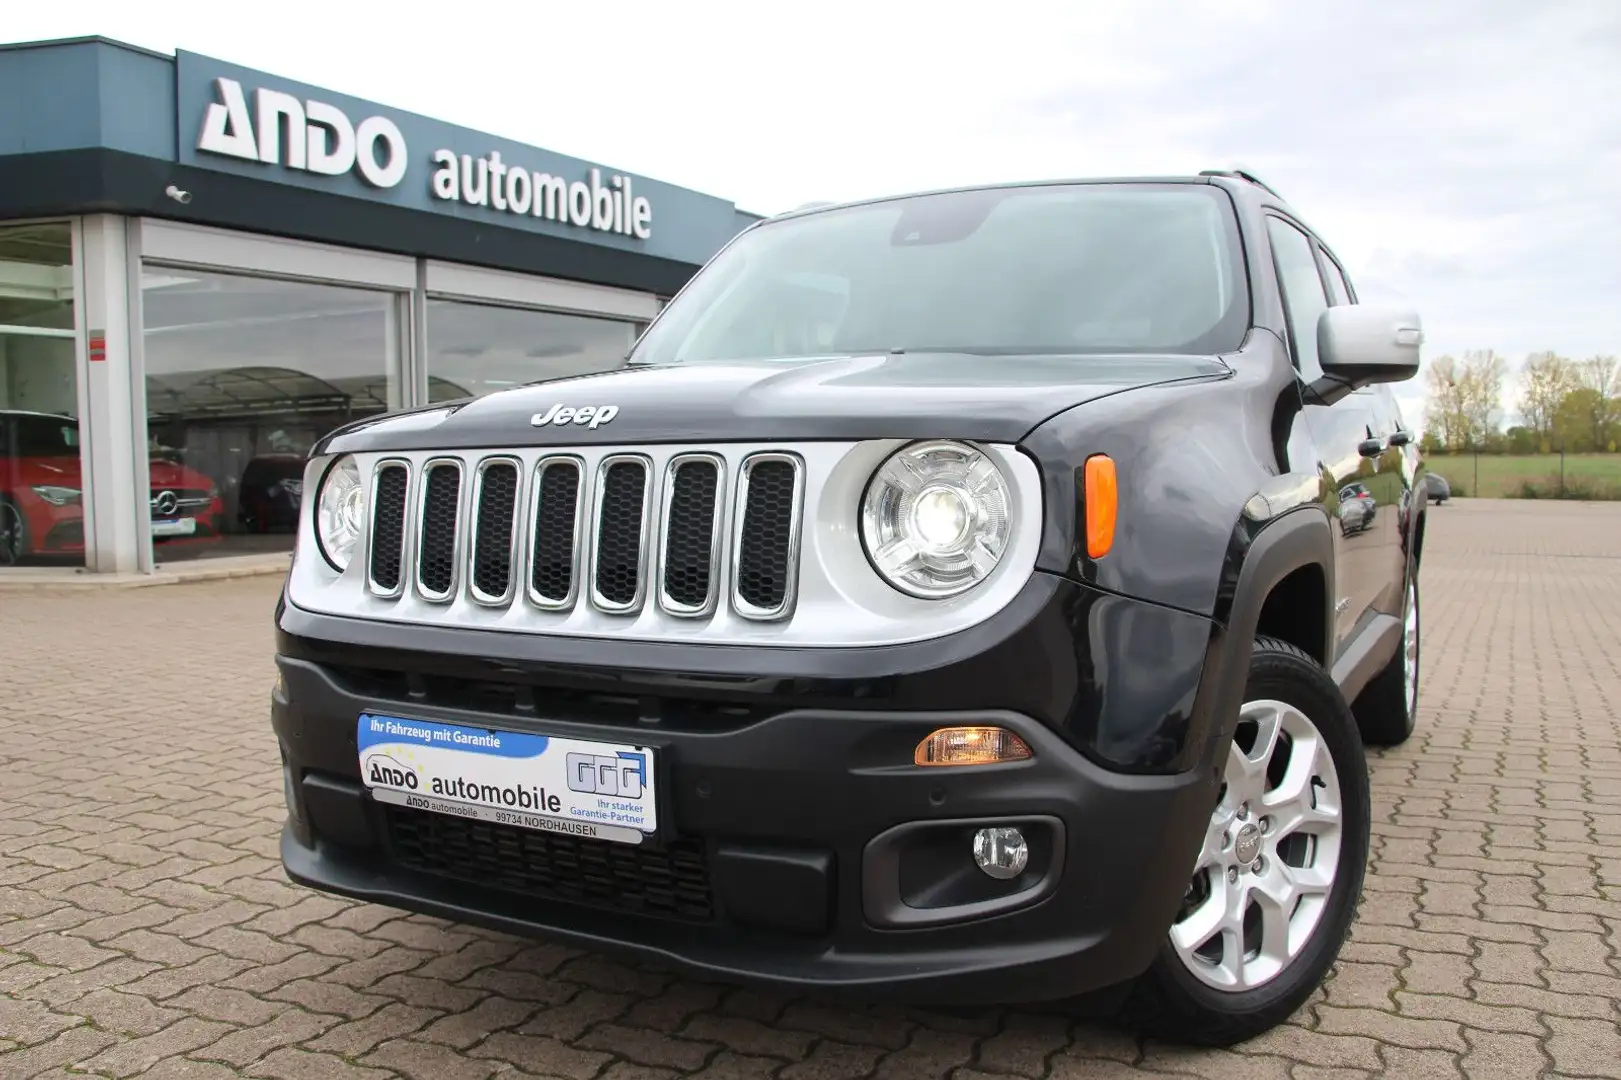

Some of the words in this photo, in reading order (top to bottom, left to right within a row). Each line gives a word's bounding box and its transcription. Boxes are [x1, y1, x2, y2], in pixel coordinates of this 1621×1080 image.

[197, 76, 408, 188] ANDO
[431, 147, 652, 239] automobile
[530, 402, 619, 430] Jeep
[370, 719, 383, 732] Ihr
[386, 721, 431, 742] Fahrzeug
[433, 728, 451, 742] mit
[453, 730, 501, 748] Garantie
[370, 763, 419, 790] ANDO
[432, 776, 561, 813] automobile
[406, 795, 430, 809] ANDO
[431, 802, 478, 818] automobile
[495, 811, 522, 825] 99734
[524, 817, 597, 836] NORDHAUSEN
[570, 806, 645, 825] Garantie-Partner
[597, 799, 609, 809] Ihr
[611, 801, 644, 813] starker
